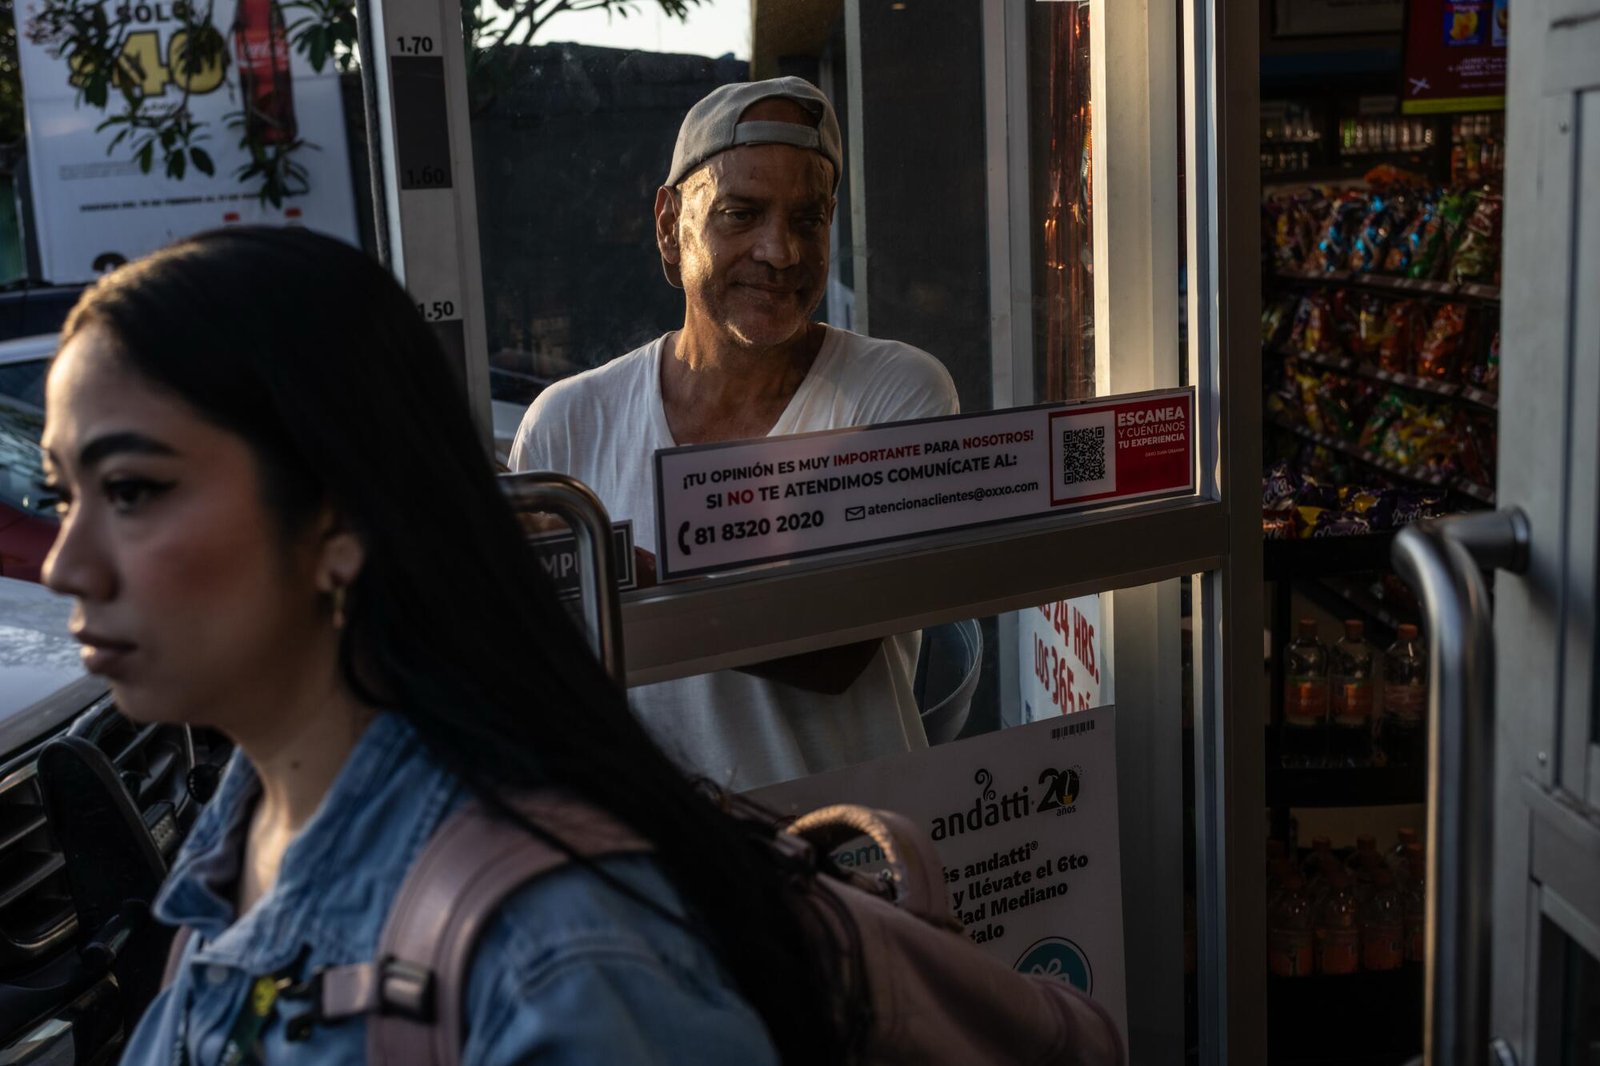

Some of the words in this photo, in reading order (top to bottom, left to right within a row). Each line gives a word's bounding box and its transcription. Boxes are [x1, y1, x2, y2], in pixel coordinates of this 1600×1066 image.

[397, 36, 433, 54] 1.70
[406, 165, 445, 186] 1.60
[418, 301, 454, 320] 1.50
[1117, 405, 1185, 427] ESCANEA
[1118, 428, 1126, 439] Y
[1126, 421, 1186, 438] CUÉNTANOS
[1118, 440, 1130, 450] TU
[1131, 432, 1185, 448] EXPERIENCIA
[682, 473, 706, 490] ¡TU
[711, 462, 774, 483] OPINIÓN
[778, 461, 795, 474] ES
[799, 456, 830, 471] MUY
[833, 445, 921, 466] IMPORTANTE
[924, 438, 960, 454] PARA
[963, 430, 1034, 449] NOSOTROS!
[706, 493, 722, 509] SI
[727, 489, 754, 507] NO
[758, 486, 780, 502] TE
[784, 471, 883, 499] ATENDIMOS
[888, 455, 991, 485] COMUNÍCATE
[994, 454, 1017, 469] AL:
[868, 480, 1039, 516] atencionaclientes@oxxo.com
[695, 526, 716, 545] 81
[722, 518, 771, 541] 8320
[776, 510, 824, 533] 2020
[539, 552, 580, 579] MP
[1054, 600, 1069, 647] 24
[1073, 607, 1099, 685] HRS.
[1034, 632, 1049, 691] LOS
[1052, 646, 1075, 715] 365
[931, 786, 1029, 841] andatti
[1037, 767, 1080, 813] 20
[1056, 804, 1077, 817] años
[952, 889, 965, 911] y
[968, 870, 1032, 901] llévate
[1036, 860, 1053, 880] el
[1057, 854, 1088, 873] 6to
[991, 882, 1068, 918] Mediano
